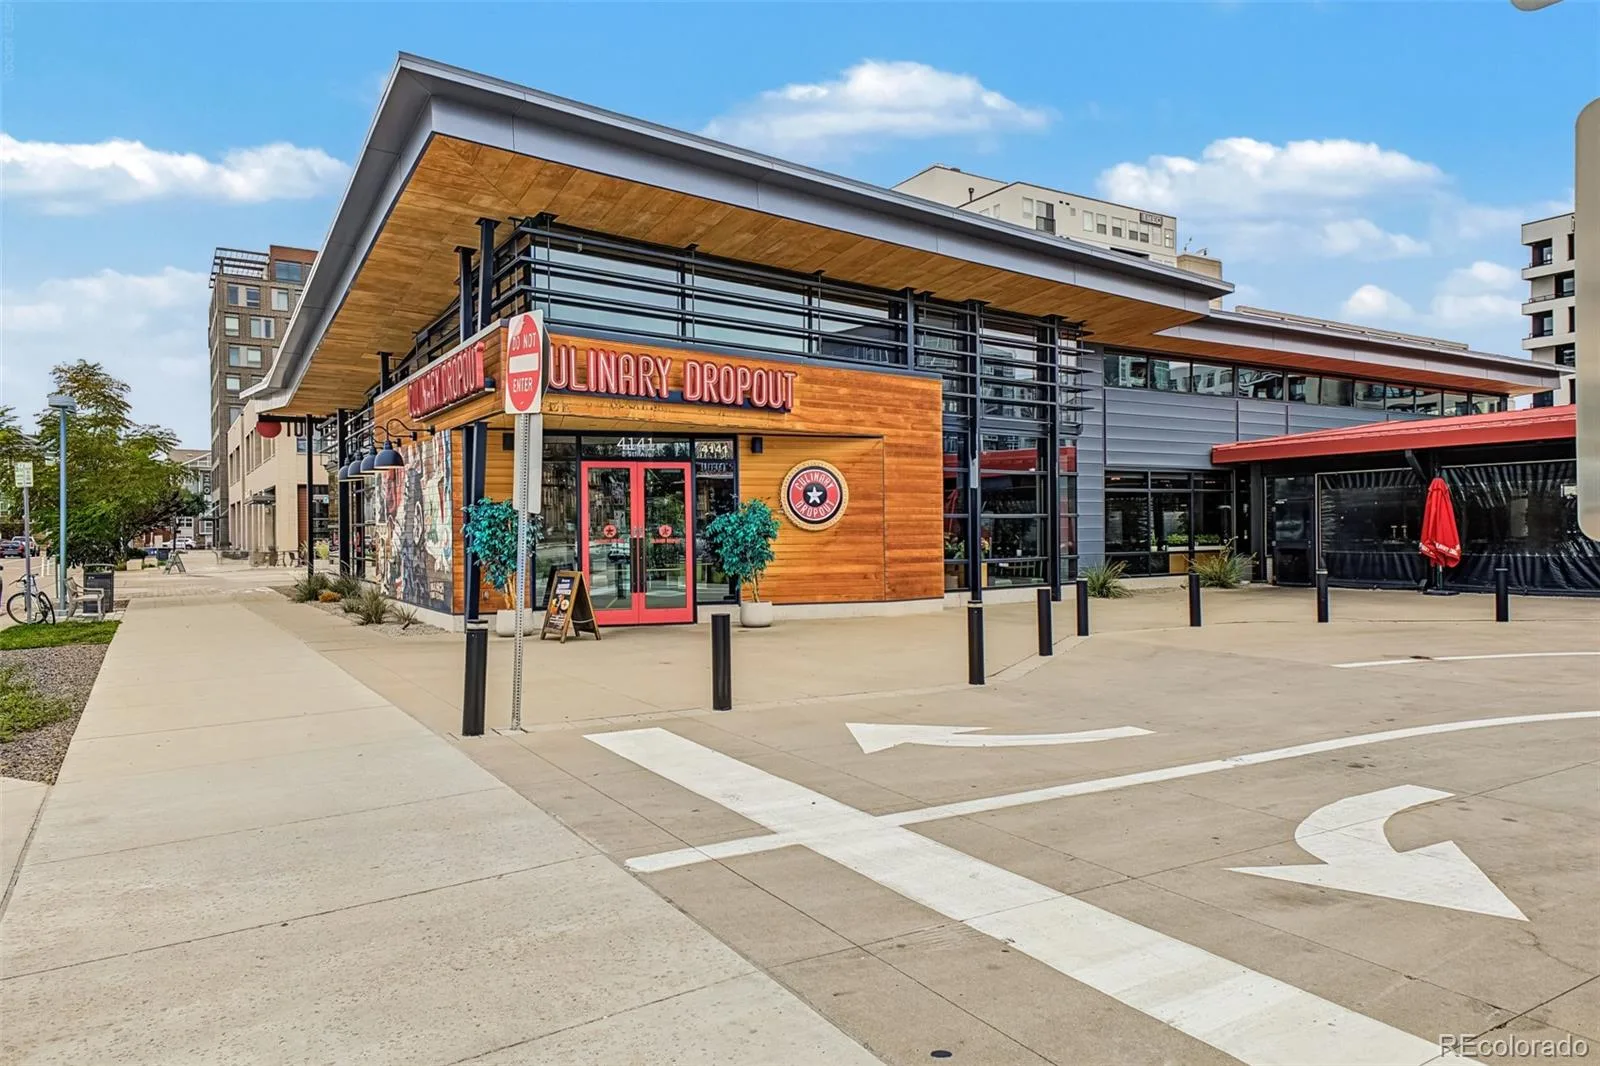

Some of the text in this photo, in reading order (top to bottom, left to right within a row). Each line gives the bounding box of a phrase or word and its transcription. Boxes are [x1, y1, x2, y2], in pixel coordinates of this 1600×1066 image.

[523, 332, 537, 349] NOT
[512, 376, 534, 393] ENTER
[548, 343, 797, 411] ULINARY DROPOUT
[617, 437, 656, 451] 4141
[794, 472, 835, 491] CULINARY
[795, 500, 835, 518] DROPOUT
